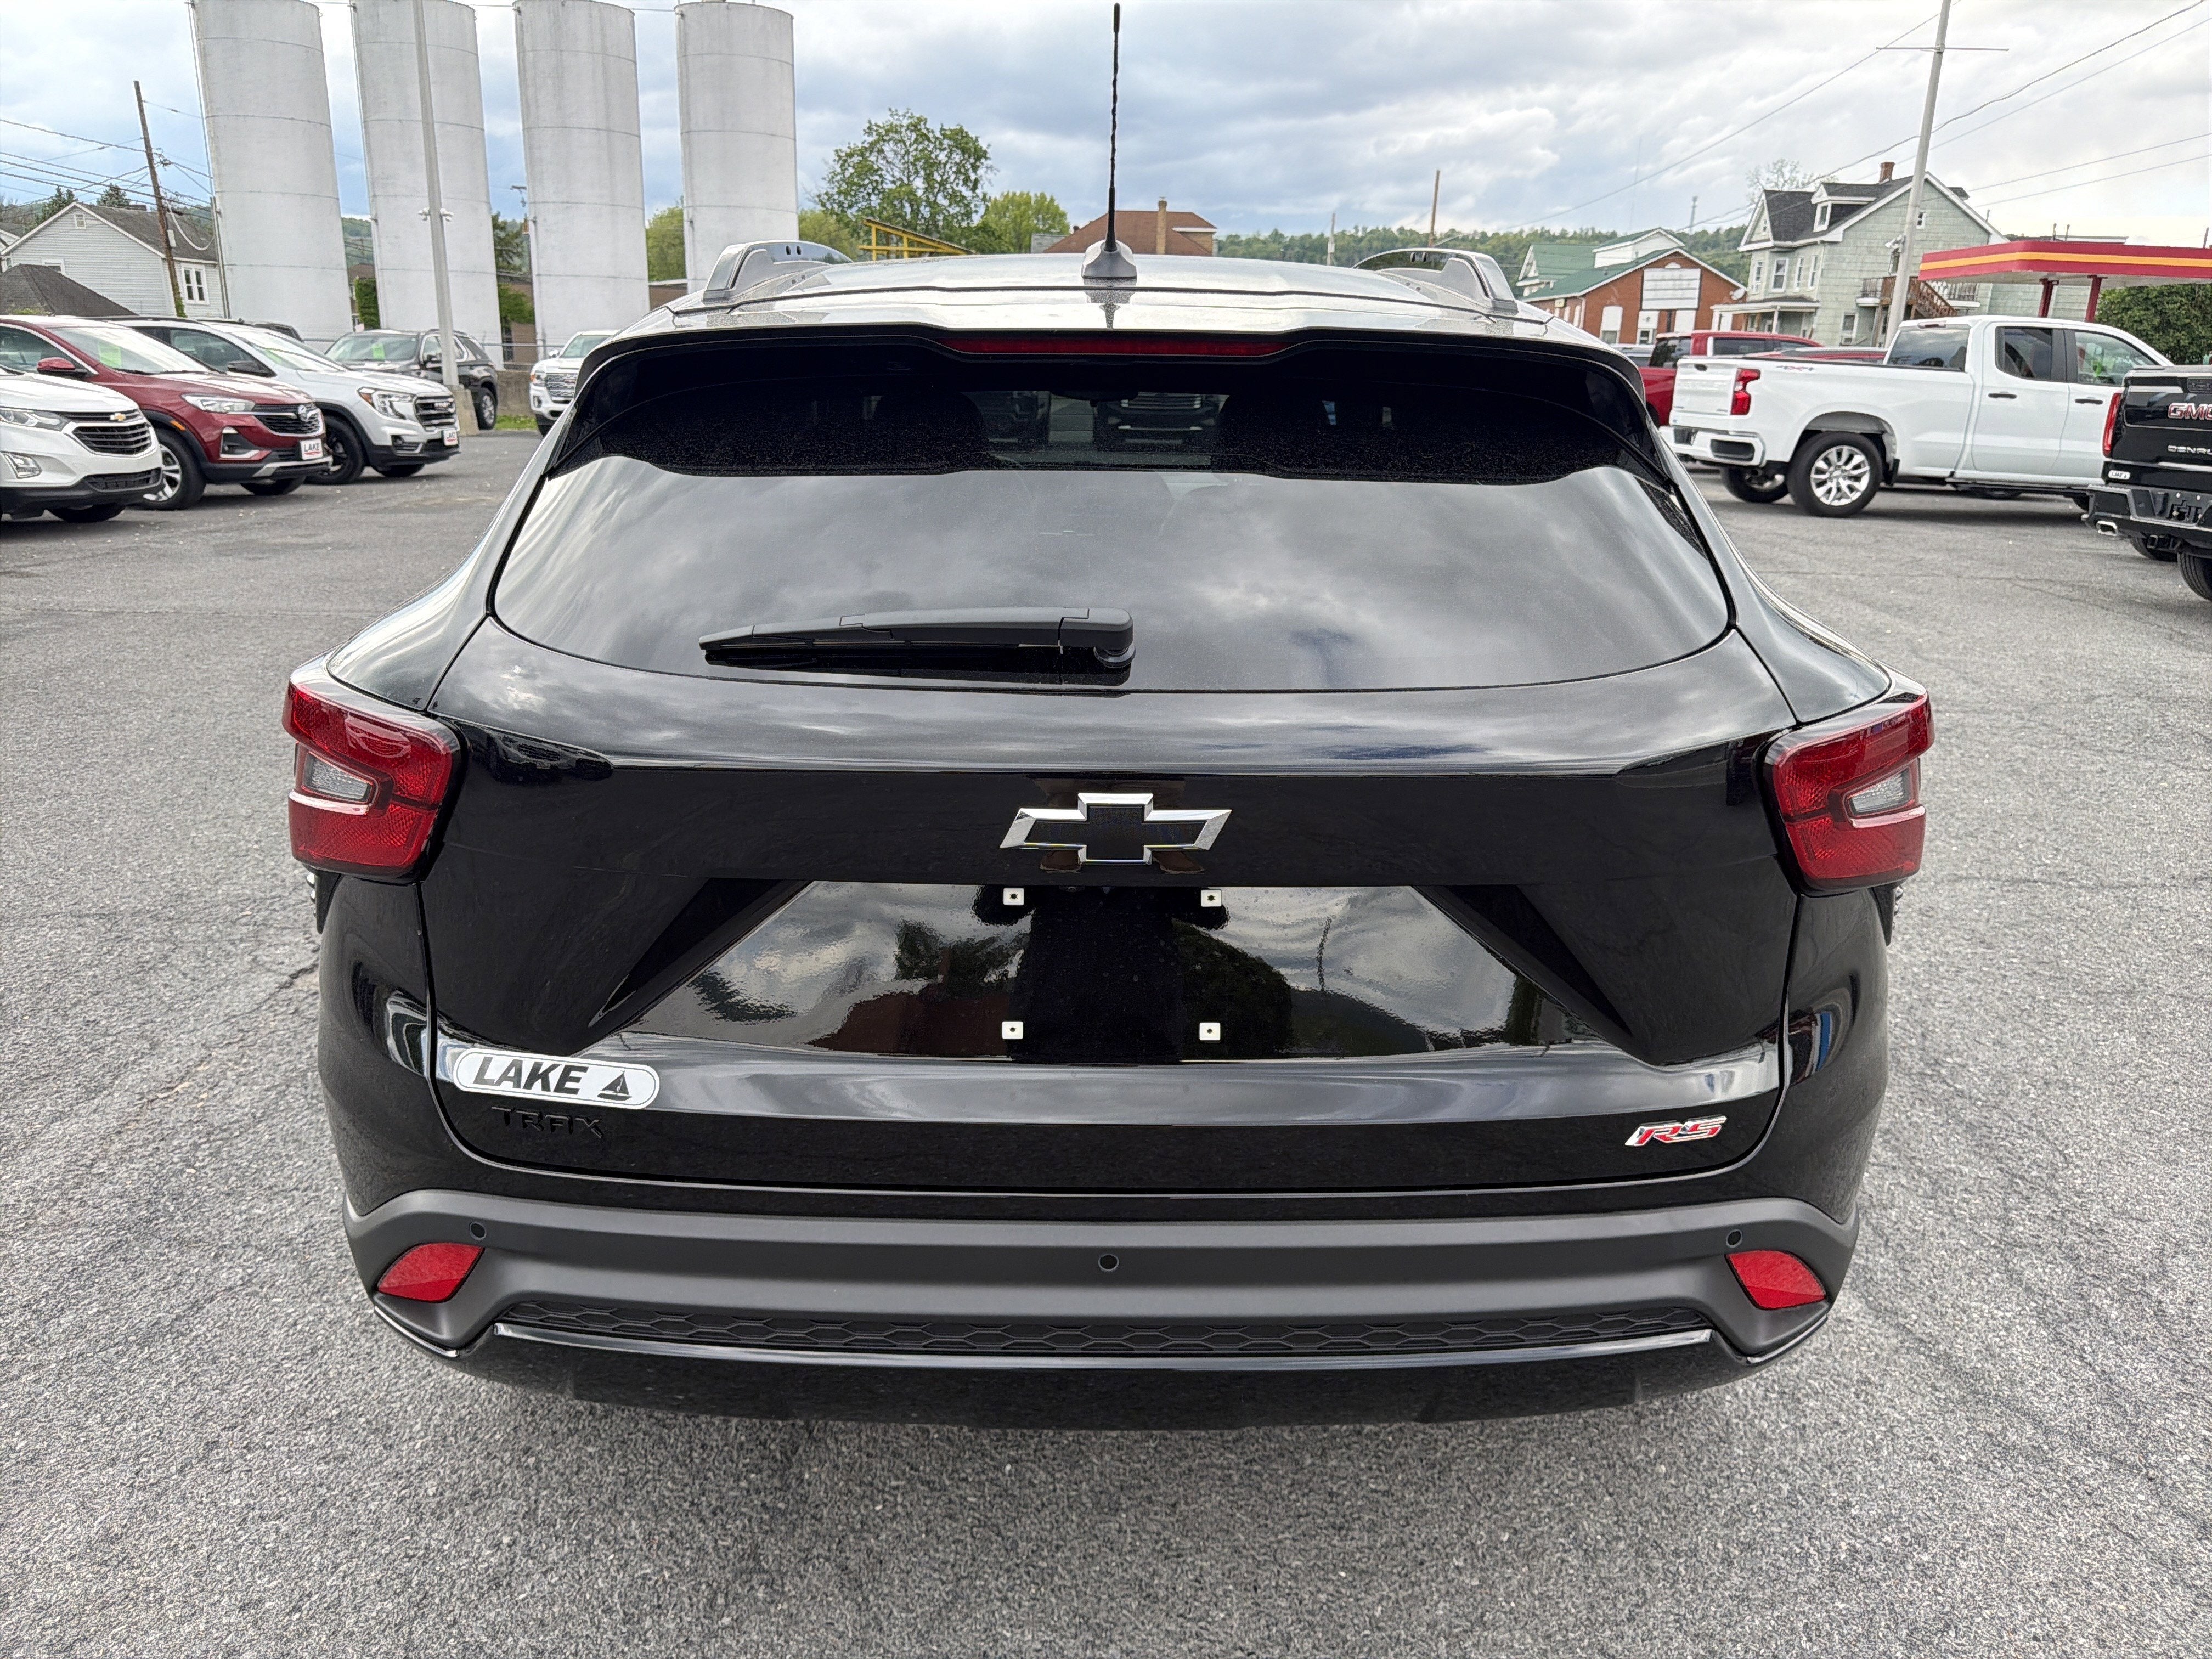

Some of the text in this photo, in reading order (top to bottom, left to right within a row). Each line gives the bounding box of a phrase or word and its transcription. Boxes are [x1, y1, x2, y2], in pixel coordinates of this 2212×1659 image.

[472, 1056, 589, 1096] LAKE
[492, 1105, 604, 1139] TRAX
[1624, 1115, 1728, 1147] RS
